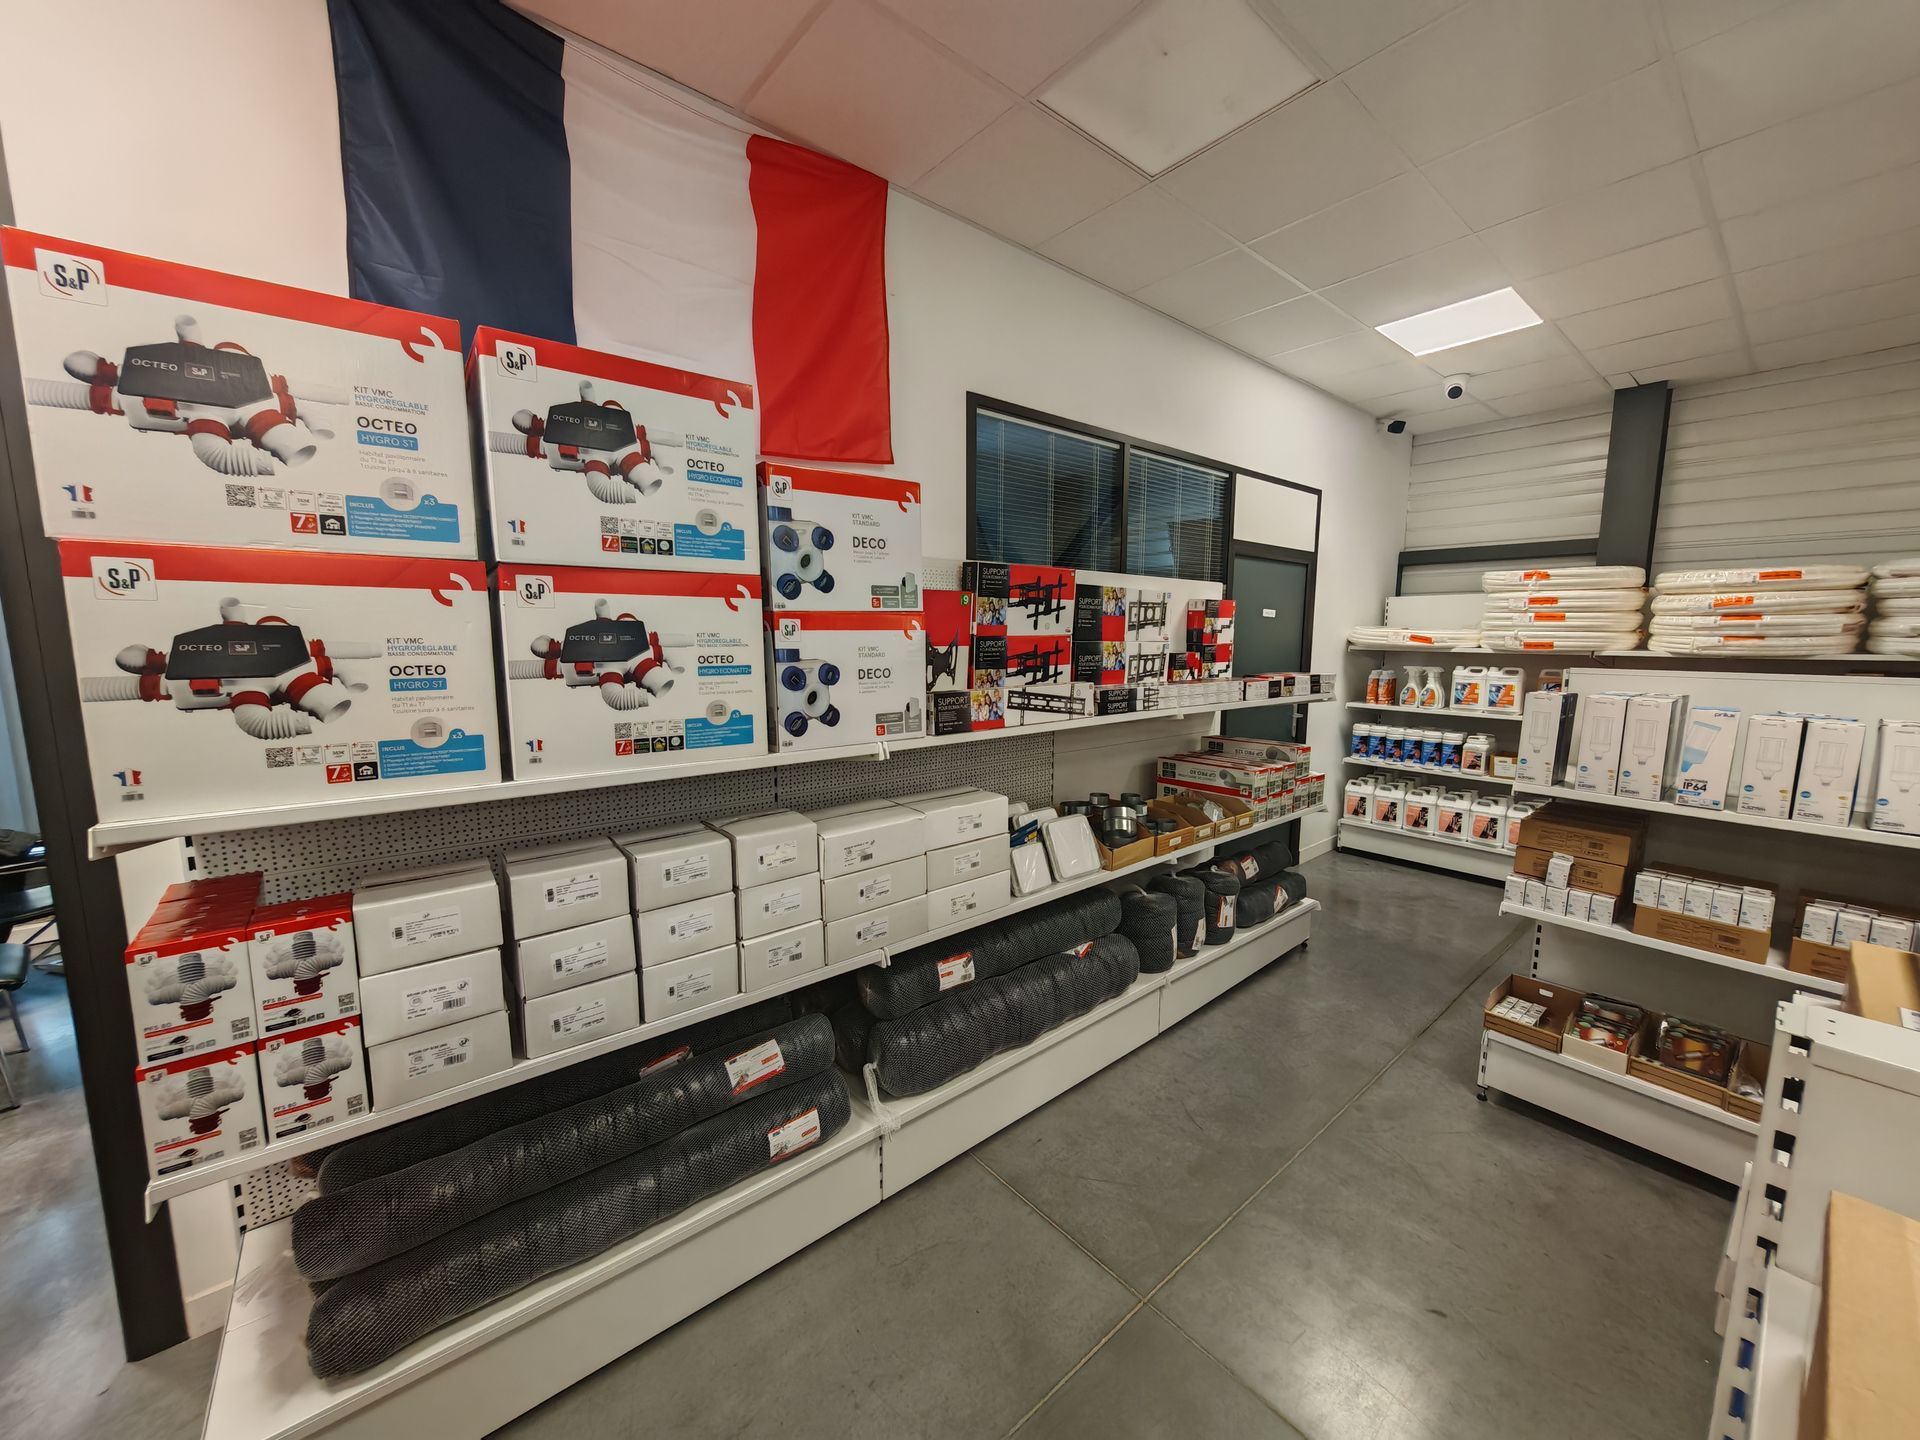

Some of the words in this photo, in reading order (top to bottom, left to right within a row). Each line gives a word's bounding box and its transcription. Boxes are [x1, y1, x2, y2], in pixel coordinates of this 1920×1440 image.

[53, 264, 90, 291] S&P
[131, 358, 178, 372] OCTEO
[506, 351, 527, 371] S&P
[353, 385, 368, 395] KIT
[371, 388, 393, 399] VMC
[357, 416, 418, 435] OCTEO
[552, 414, 581, 425] OCTEO
[361, 434, 400, 447] HYGRO
[402, 439, 416, 448] ST
[686, 458, 725, 473] OCTEO
[293, 514, 306, 529] 7
[603, 535, 612, 549] 7
[852, 536, 886, 550] DECO
[982, 567, 1009, 576] SUPPORT
[108, 567, 141, 590] S&P
[525, 582, 545, 600] S&P
[1078, 597, 1102, 606] SUPPORT
[178, 643, 223, 652] OCTEO
[386, 637, 401, 645] KIT
[403, 637, 425, 645] VMC
[979, 640, 1005, 648] SUPPORT
[697, 654, 735, 665] OCTEO
[1078, 654, 1102, 663] SUPPORT
[389, 664, 447, 677] OCTEO
[858, 667, 892, 680] DECO
[393, 680, 430, 690] HYGRO
[432, 680, 444, 688] ST
[938, 696, 968, 706] SUPPORT
[1107, 701, 1128, 710] SUPPORT
[617, 741, 626, 753] 7
[330, 765, 341, 780] 7
[1682, 782, 1708, 792] IP64
